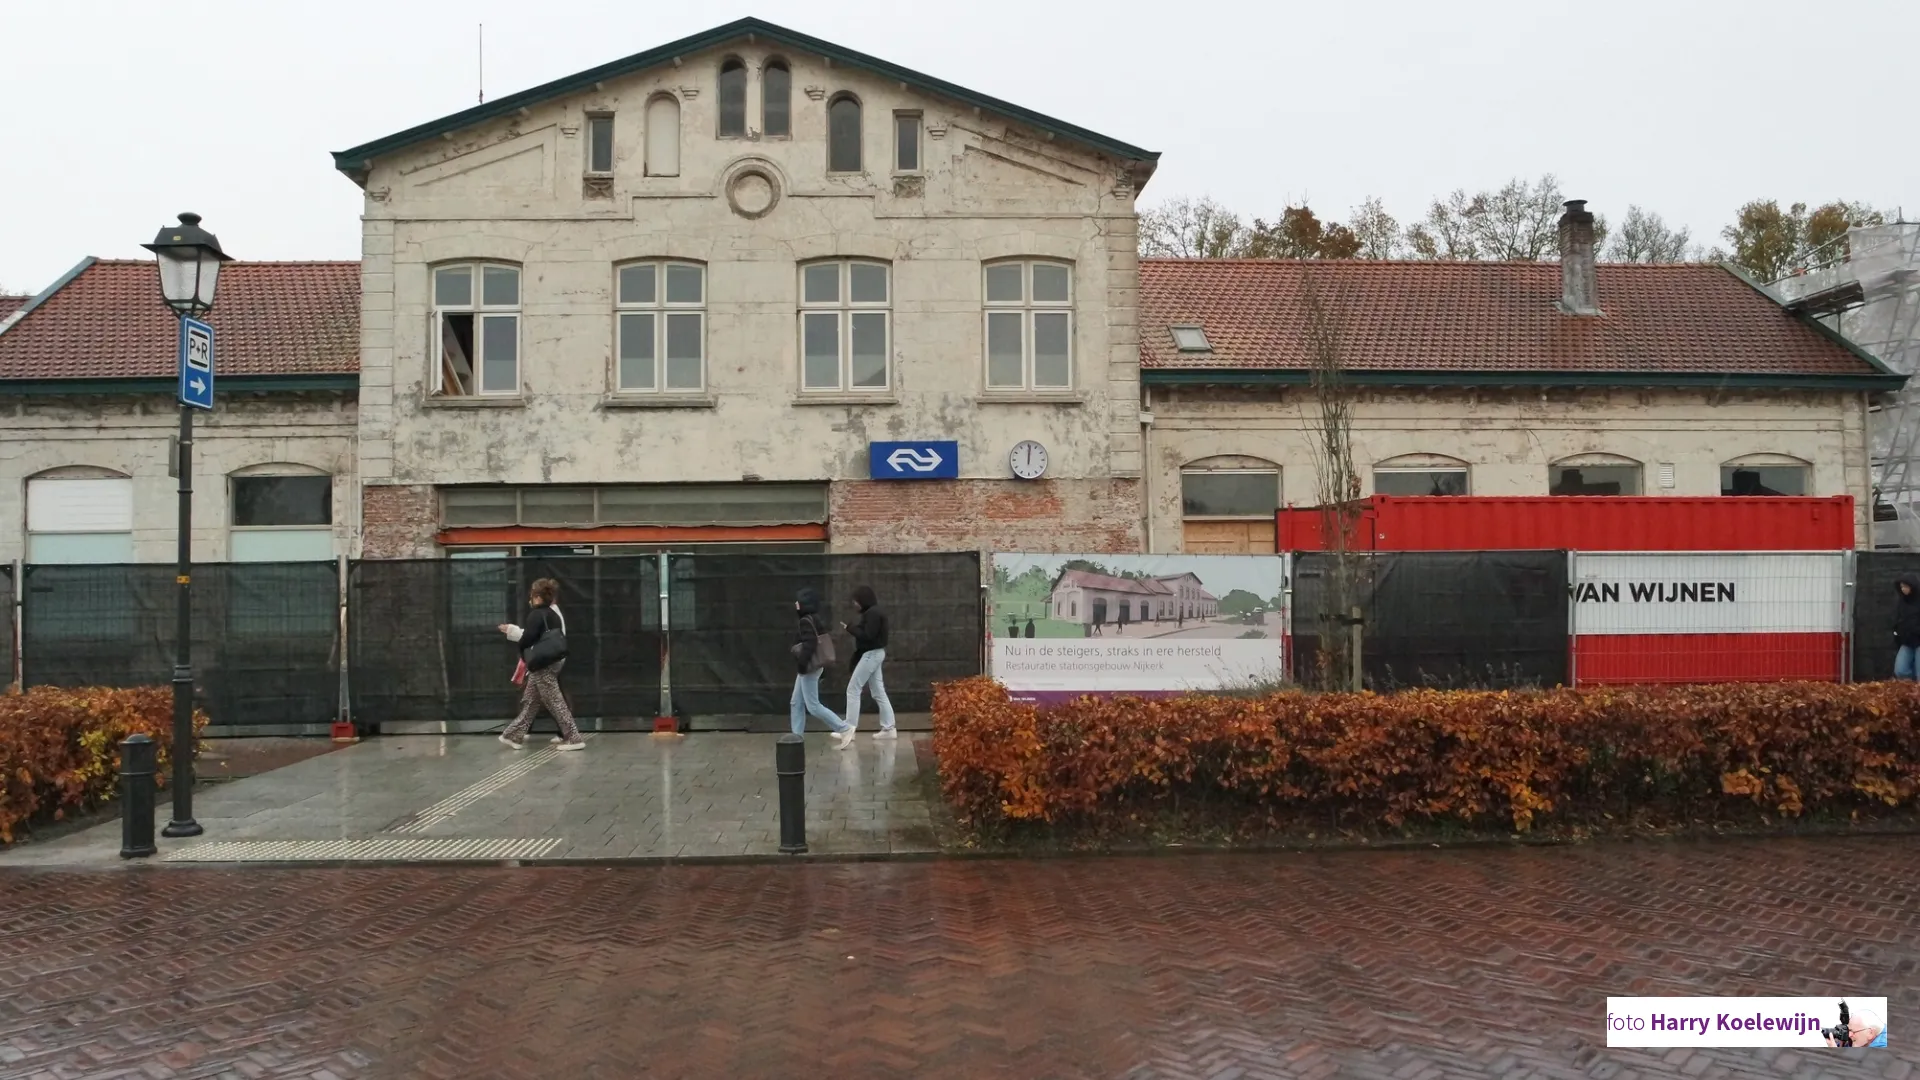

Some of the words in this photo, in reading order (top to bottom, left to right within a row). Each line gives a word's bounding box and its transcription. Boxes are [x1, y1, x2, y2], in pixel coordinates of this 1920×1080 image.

[189, 338, 208, 360] P+R
[1629, 582, 1735, 602] WIJNEN
[1005, 645, 1021, 656] Nu
[1025, 645, 1036, 656] in
[1040, 644, 1054, 656] de
[1057, 645, 1103, 659] steigers,
[1107, 646, 1139, 657] straks
[1143, 646, 1154, 656] in
[1156, 648, 1174, 656] ere
[1177, 645, 1221, 656] hersteld
[1006, 661, 1056, 670] Restauratie
[1060, 661, 1130, 673] stationsgebouw
[1134, 661, 1164, 672] Nijkerk
